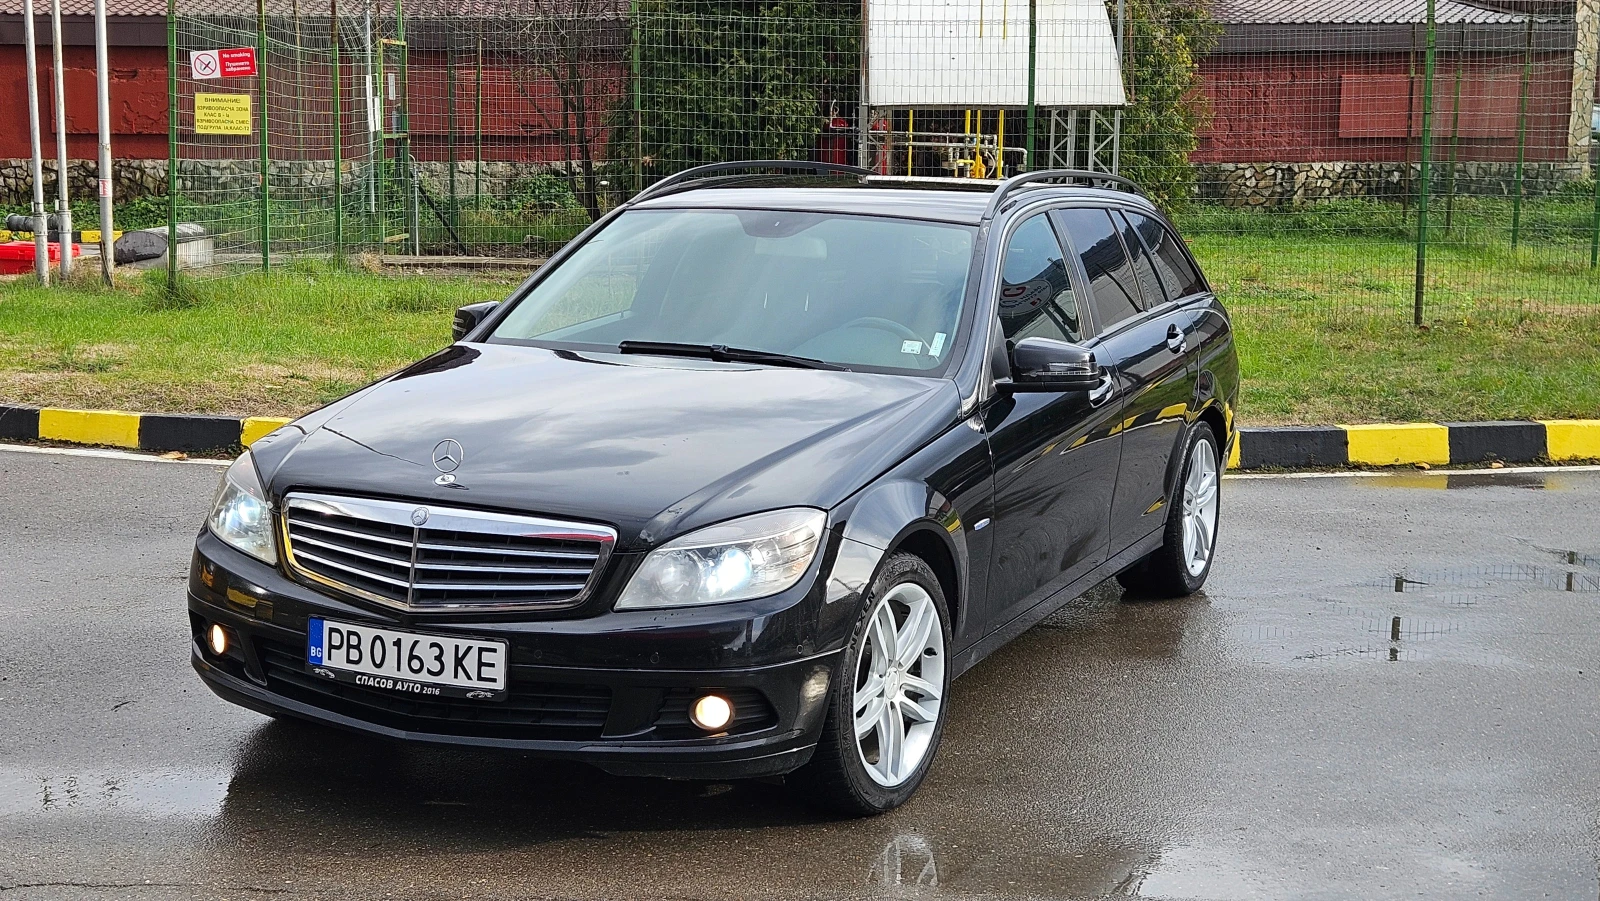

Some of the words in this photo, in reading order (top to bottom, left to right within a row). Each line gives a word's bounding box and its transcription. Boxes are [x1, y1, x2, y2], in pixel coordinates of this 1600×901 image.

[850, 591, 876, 650] NEXEN
[310, 646, 322, 658] BG
[369, 634, 445, 677] 0163
[355, 675, 393, 689] СПАСОВ
[395, 681, 421, 693] АУТО
[422, 686, 441, 696] 2016
